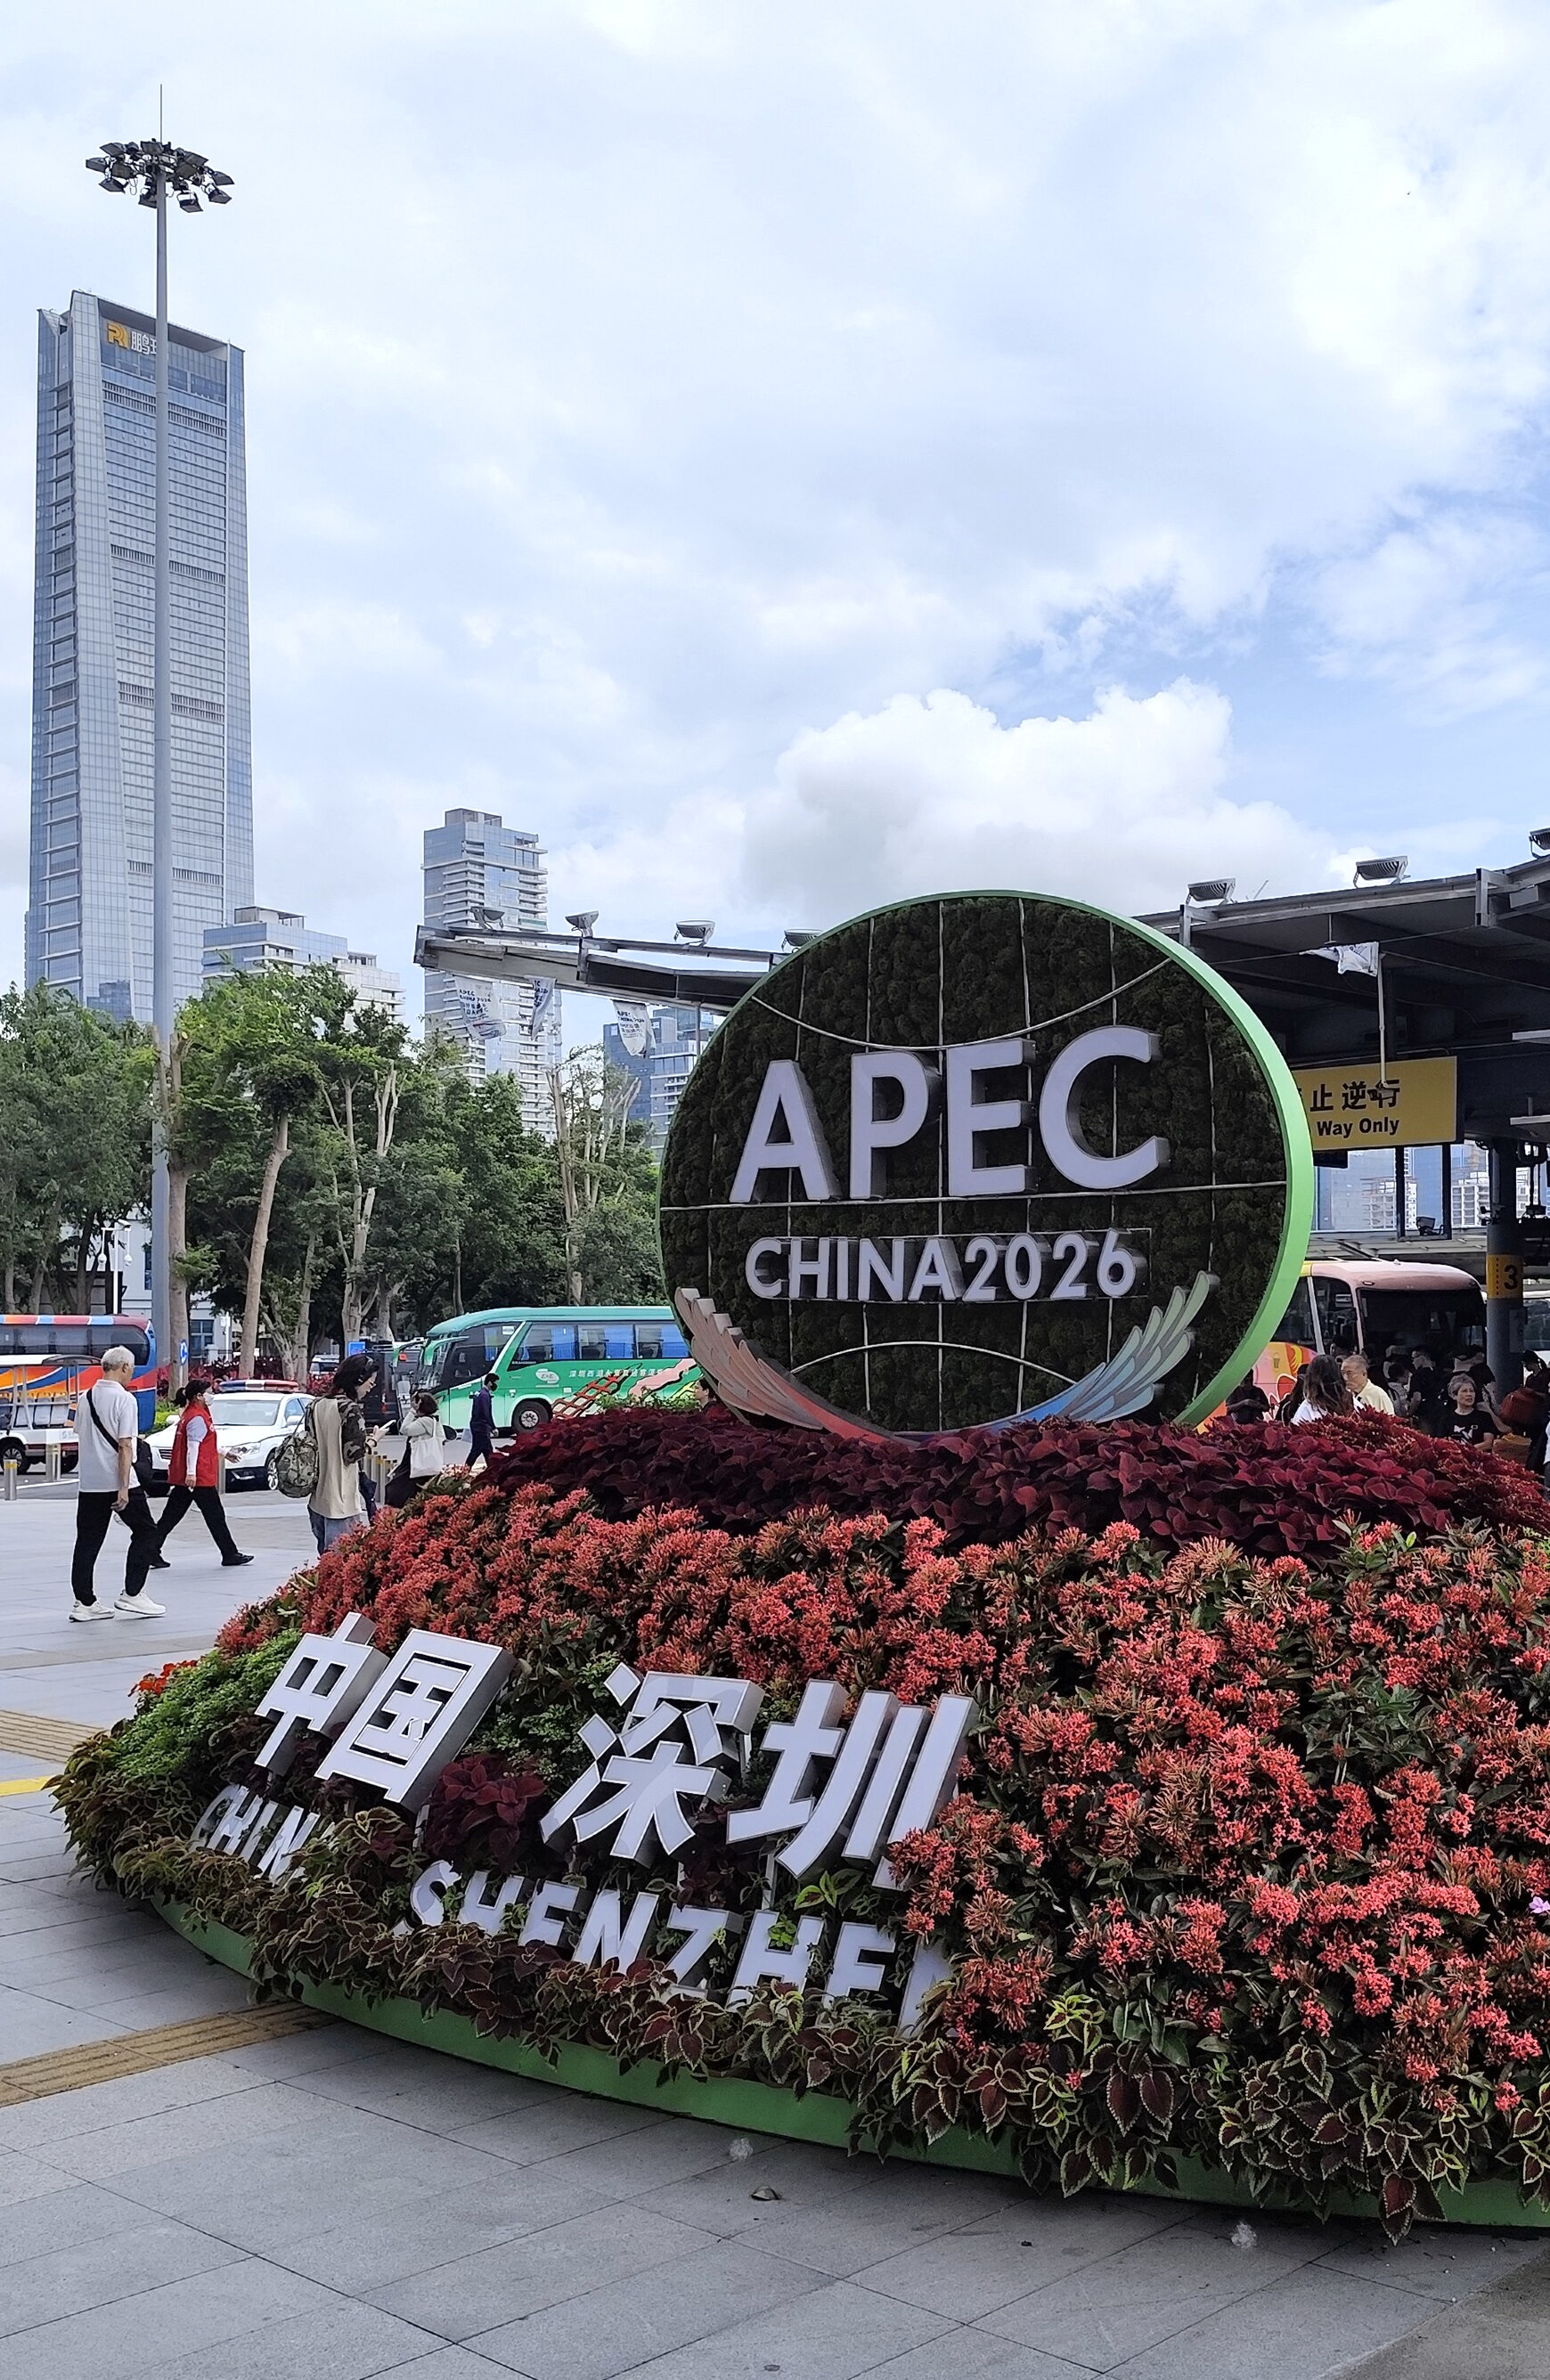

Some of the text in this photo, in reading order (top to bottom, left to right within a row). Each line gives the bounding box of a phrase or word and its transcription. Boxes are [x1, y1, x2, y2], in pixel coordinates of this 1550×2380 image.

[729, 1024, 1163, 1203] APEC
[1298, 1079, 1400, 1113] 止逆行
[1317, 1116, 1399, 1138] Way Only
[1504, 1265, 1518, 1290] 3
[254, 1611, 975, 1891] 中国 深圳
[188, 1783, 335, 1891] CHIN
